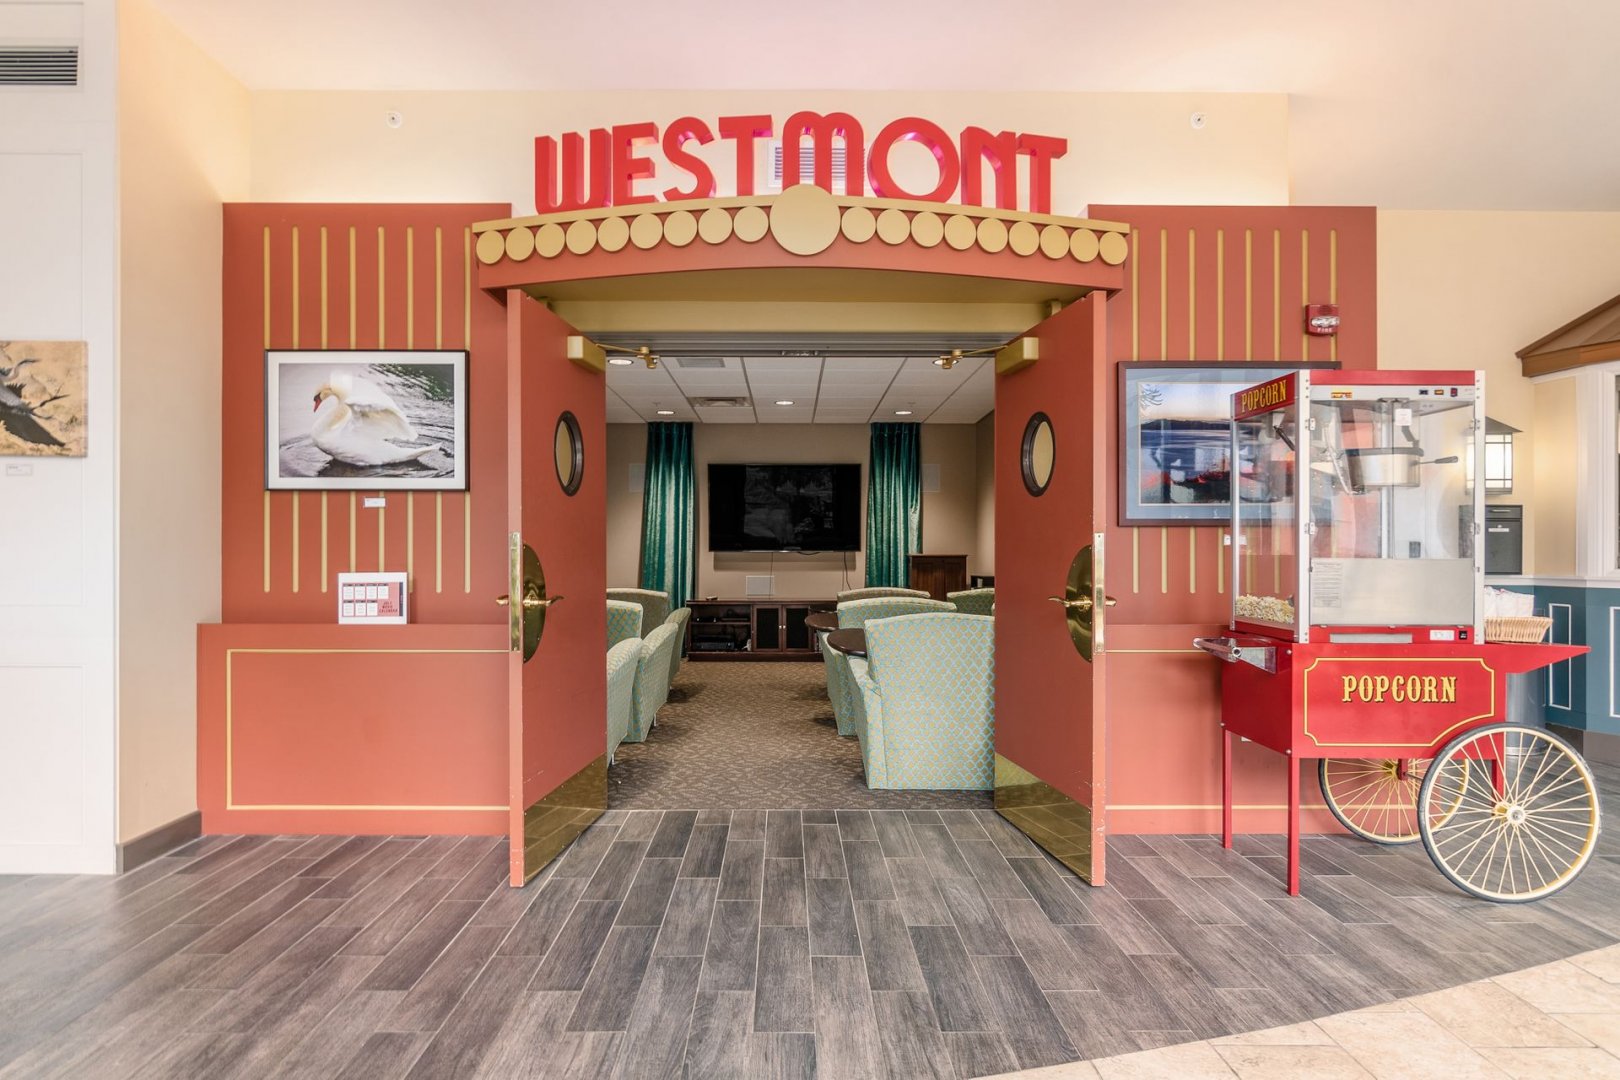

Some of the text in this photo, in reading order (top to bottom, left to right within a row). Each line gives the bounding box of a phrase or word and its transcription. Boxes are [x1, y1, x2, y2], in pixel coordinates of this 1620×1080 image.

[534, 111, 1068, 215] WESTMONT
[1241, 379, 1287, 413] POPCORN
[1342, 675, 1457, 703] POPCORN
